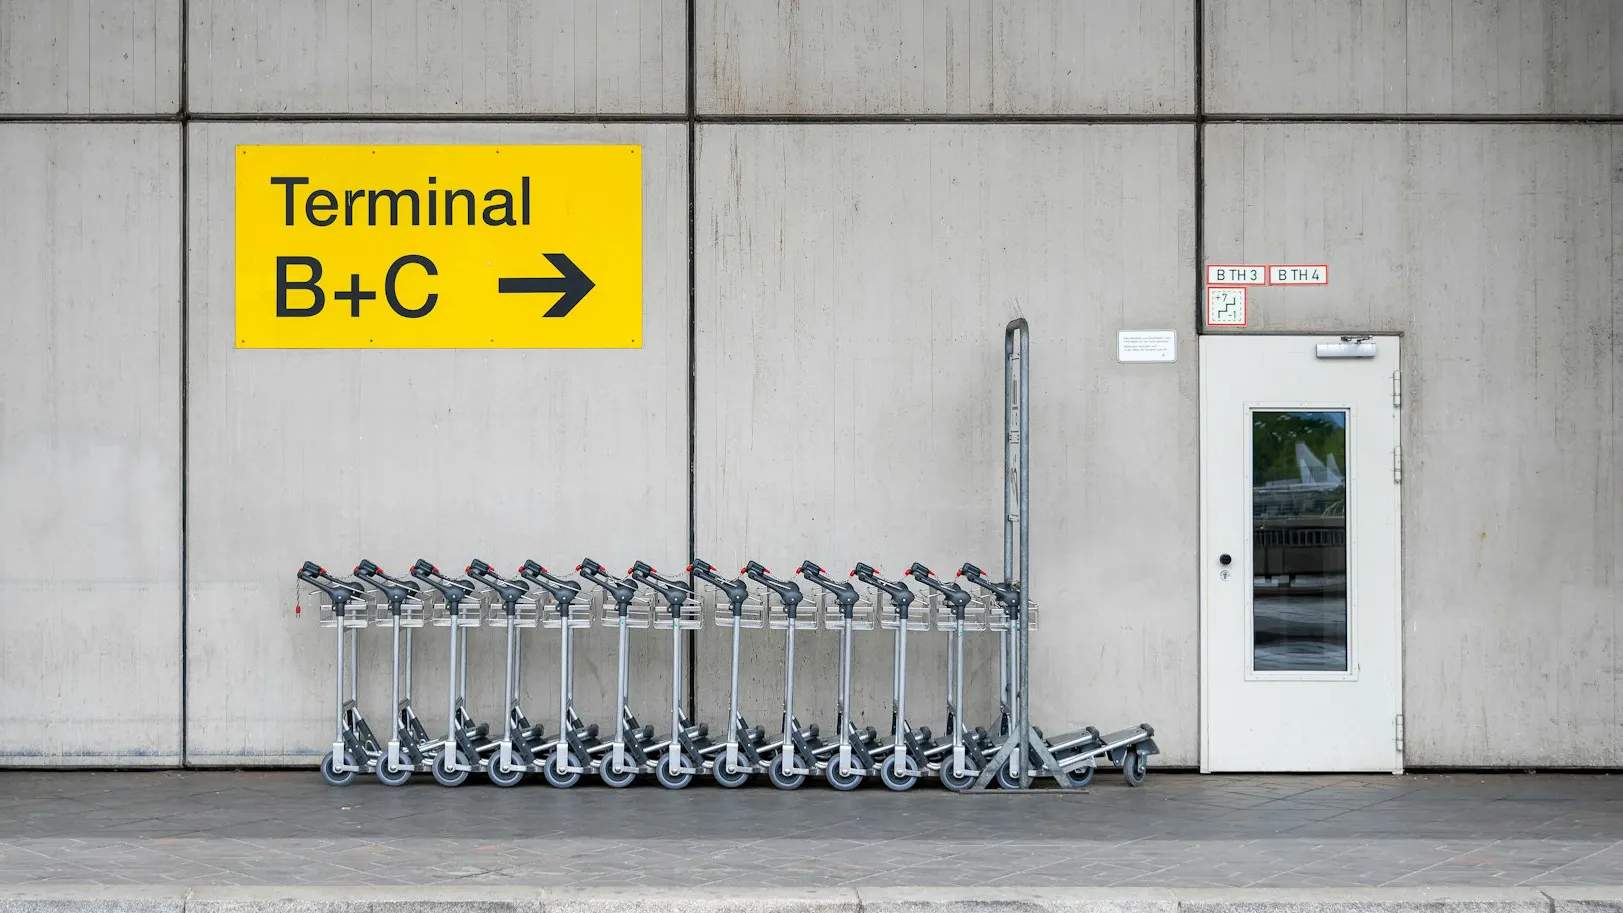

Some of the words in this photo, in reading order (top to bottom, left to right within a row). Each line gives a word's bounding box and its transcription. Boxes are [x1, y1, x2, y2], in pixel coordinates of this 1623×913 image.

[271, 176, 530, 226] Terminal
[276, 254, 439, 318] B+C
[1217, 269, 1225, 281] B
[1229, 269, 1246, 281] TH
[1250, 269, 1257, 281] 3
[1278, 269, 1287, 281] B
[1291, 269, 1308, 281] TH
[1312, 269, 1319, 281] 4
